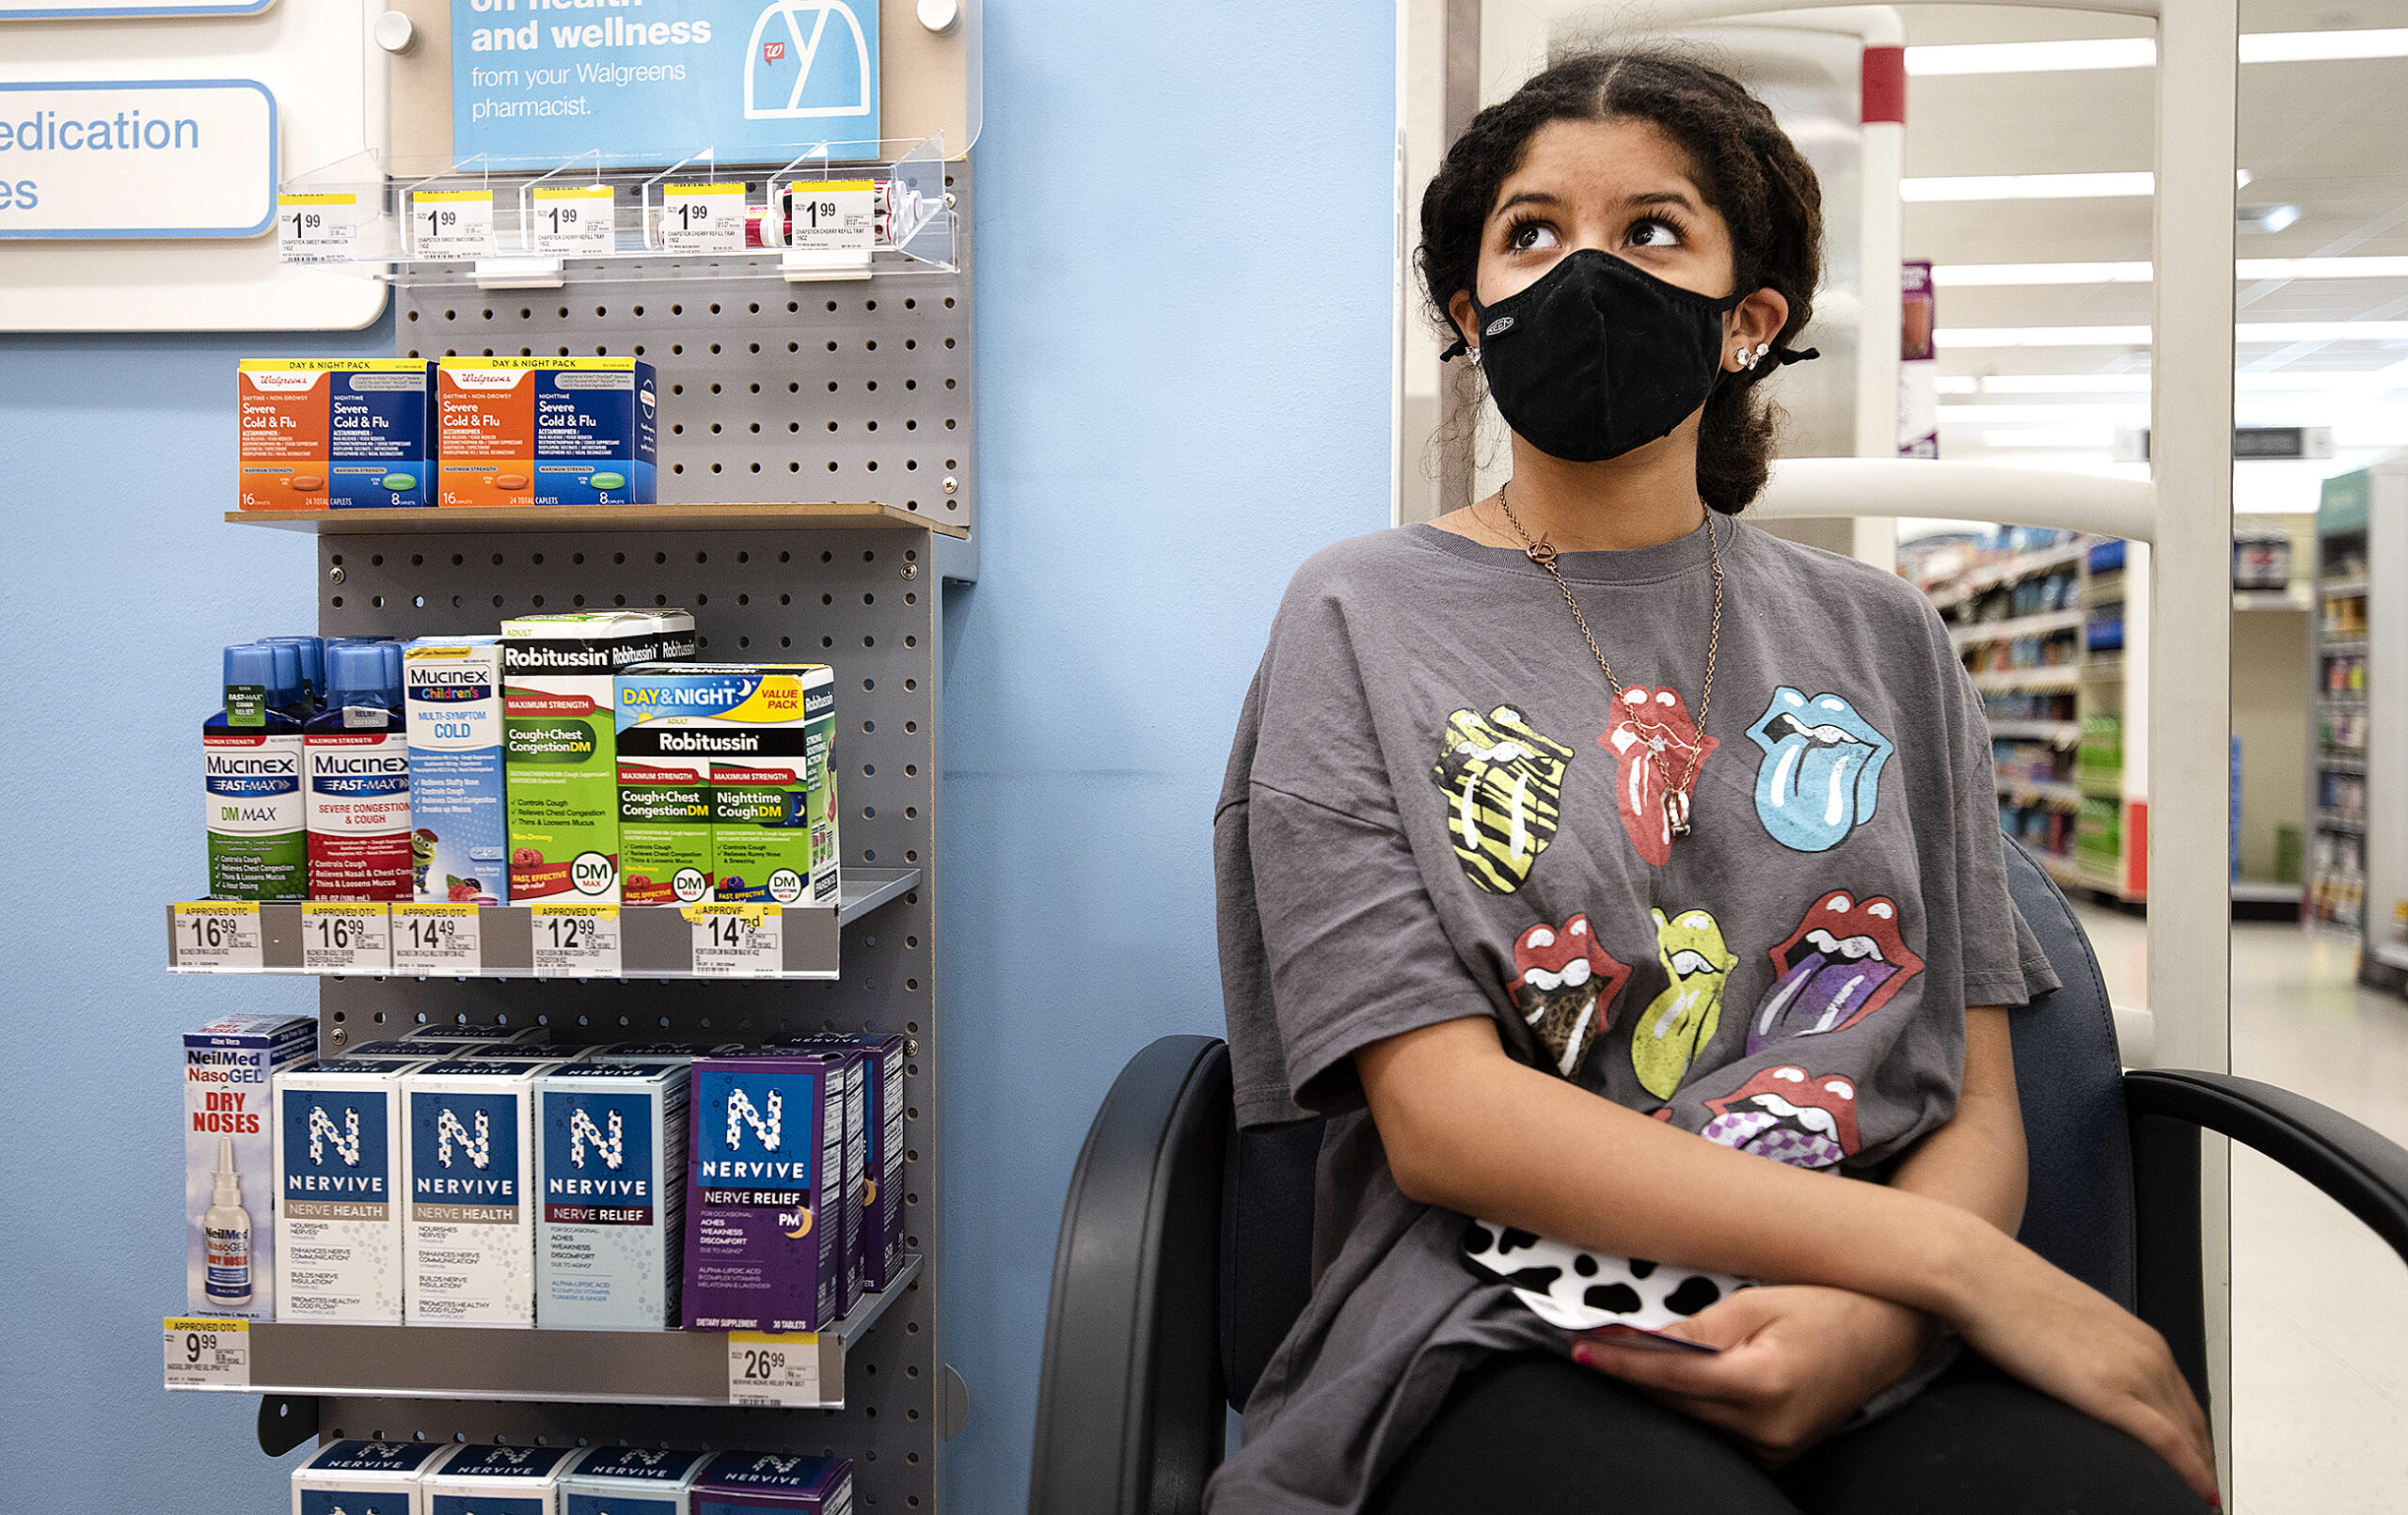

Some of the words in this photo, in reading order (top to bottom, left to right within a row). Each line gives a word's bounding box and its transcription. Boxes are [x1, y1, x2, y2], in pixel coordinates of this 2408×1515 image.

[471, 19, 538, 52] and
[550, 16, 712, 49] wellness
[471, 68, 518, 87] from
[525, 69, 570, 90] your
[576, 61, 687, 86] Walgreens
[471, 97, 592, 122] pharmacist.
[261, 375, 308, 387] Walgreens
[462, 373, 511, 385] Walgreens
[243, 402, 276, 414] Severe
[334, 402, 368, 414] Severe
[443, 401, 479, 413] Severe
[539, 401, 575, 413] Severe
[243, 417, 267, 428] Cold
[268, 417, 277, 428] &
[280, 417, 296, 428] Flu
[334, 417, 358, 428] Cold
[360, 417, 370, 428] &
[372, 417, 389, 428] Flu
[443, 414, 469, 427] Cold
[470, 414, 483, 427] &
[483, 414, 500, 427] Flu
[539, 414, 564, 427] Cold
[566, 414, 577, 427] &
[578, 414, 596, 427] Flu
[242, 493, 255, 505] 16
[391, 493, 400, 505] 8
[443, 492, 456, 504] 16
[535, 497, 558, 505] CAPLETS
[599, 492, 609, 504] 8
[506, 628, 532, 637] ADULT
[612, 643, 654, 665] Robitussin
[662, 640, 695, 659] Robitussin
[505, 647, 608, 668] Robitussin
[410, 669, 488, 685] Mucinex
[421, 686, 480, 700] Children's
[761, 688, 798, 699] VALUE
[508, 700, 547, 709] MAXIMUM
[548, 700, 589, 709] STRENGTH
[768, 699, 798, 709] PACK
[418, 711, 486, 720] MULTI-SYMPTOM
[435, 723, 470, 739] COLD
[659, 733, 756, 751] Robitussin
[207, 756, 293, 774] Mucinex
[621, 772, 655, 781] MAXIMUM
[657, 772, 692, 781] STRENGTH
[713, 772, 750, 781] MAXIMUM
[752, 772, 787, 781] STRENGTH
[220, 779, 277, 792] FAST-MAX
[332, 779, 396, 791] FAST-MAX
[717, 791, 782, 805] Nighttime
[221, 807, 239, 821] DM
[243, 807, 277, 821] MAX
[354, 802, 411, 813] CONGESTION
[355, 814, 386, 824] COUGH
[576, 863, 608, 878] DM
[676, 876, 702, 889] DM
[773, 876, 796, 888] DM
[184, 907, 227, 916] APPROVED
[229, 907, 248, 916] OTC
[357, 908, 376, 917] OTC
[403, 908, 444, 917] APPROVED
[447, 908, 467, 917] OTC
[210, 1037, 225, 1046] Aloe
[227, 1037, 241, 1046] Vera
[187, 1049, 260, 1065] NeilMed
[188, 1068, 262, 1083] NasoGEL
[205, 1092, 246, 1113] DRY
[192, 1113, 260, 1134] NOSES
[725, 1088, 783, 1153] N
[309, 1106, 359, 1168] N
[437, 1108, 489, 1172] N
[570, 1108, 623, 1171] N
[702, 1160, 804, 1179] NERVIVE
[289, 1175, 383, 1191] NERVIVE
[418, 1177, 514, 1195] NERVIVE
[550, 1177, 646, 1196] NERVIVE
[705, 1191, 751, 1204] NERVE
[753, 1192, 800, 1205] RELIEF
[289, 1204, 330, 1216] NERVE
[333, 1206, 382, 1217] HEALTH
[418, 1207, 459, 1219] NERVE
[462, 1207, 514, 1221] HEALTH
[553, 1207, 596, 1221] NERVE
[599, 1208, 643, 1221] RELIEF
[778, 1213, 800, 1226] PM
[205, 1227, 248, 1239] NeilMed
[173, 1323, 218, 1332] APPROVED
[220, 1324, 237, 1333] OTC
[696, 1318, 718, 1327] DIETARY
[720, 1318, 758, 1329] SUPPLEMENT
[781, 1319, 806, 1330] TABLETS
[327, 1460, 404, 1469] NERVIVE
[458, 1465, 532, 1476] NERVIVE
[592, 1465, 668, 1478] NERVIVE
[725, 1472, 800, 1486] NERVIVE
